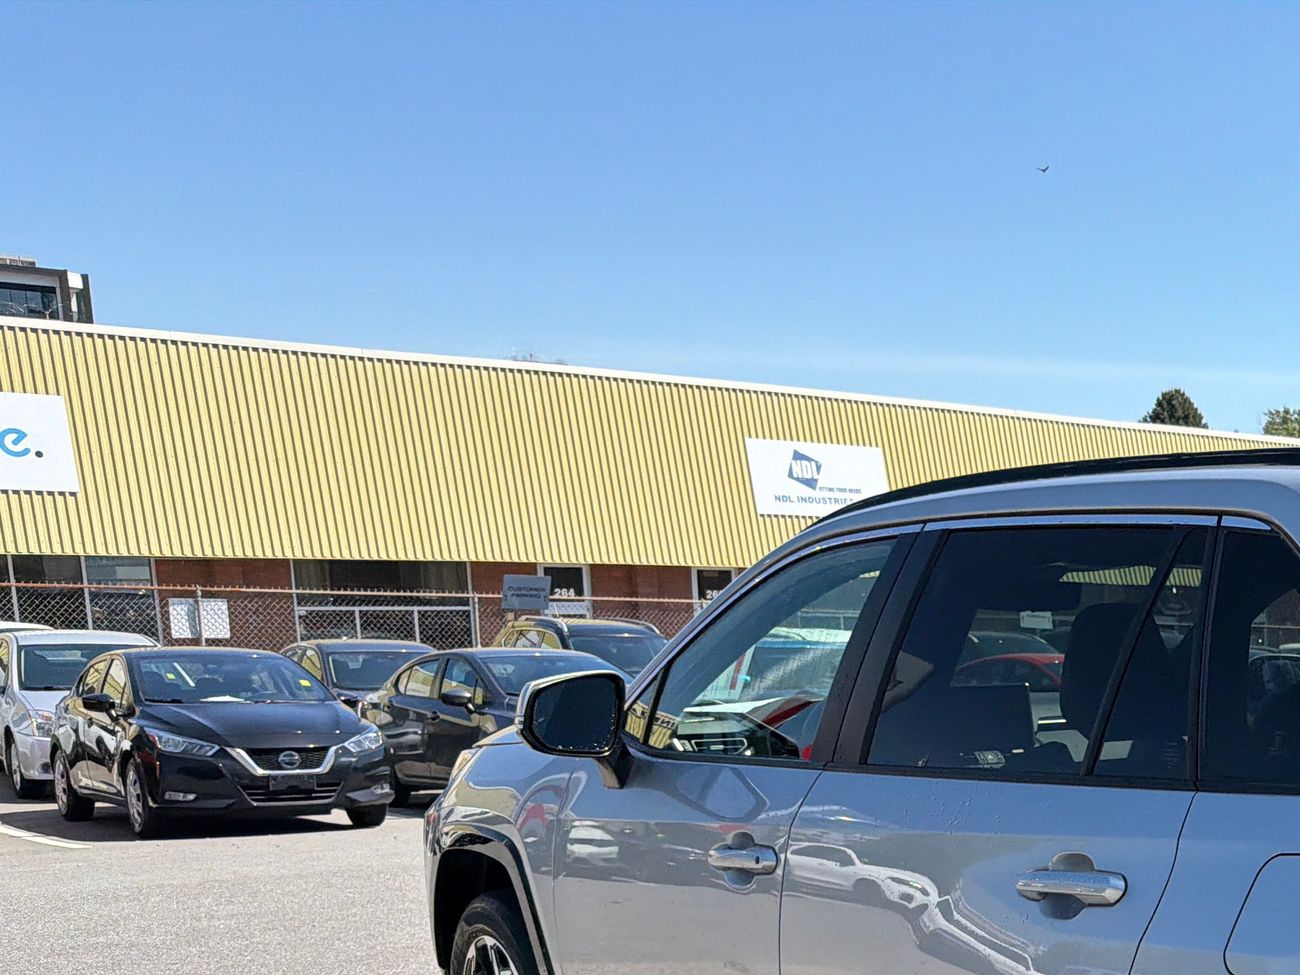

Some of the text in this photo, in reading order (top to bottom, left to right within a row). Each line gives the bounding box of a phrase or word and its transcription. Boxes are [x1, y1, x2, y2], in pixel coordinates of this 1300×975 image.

[791, 459, 821, 480] NDL
[774, 494, 795, 503] NDL
[554, 588, 576, 597] 264
